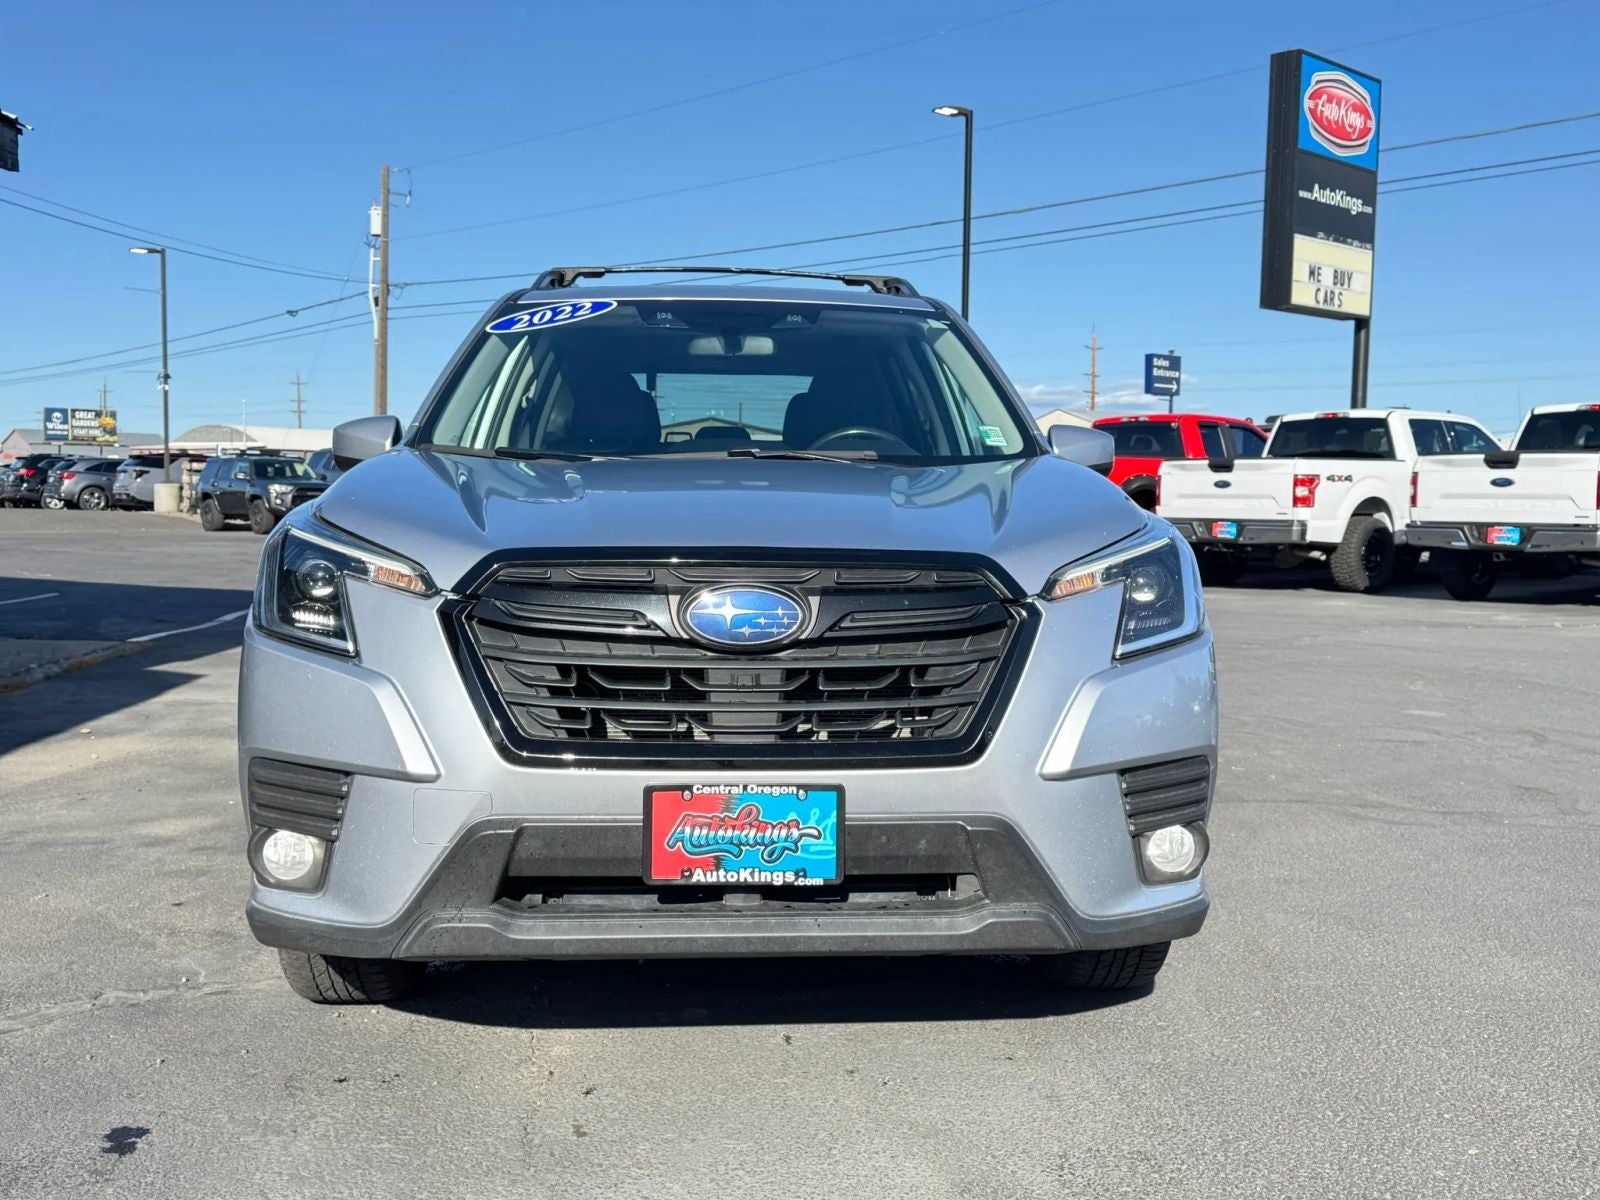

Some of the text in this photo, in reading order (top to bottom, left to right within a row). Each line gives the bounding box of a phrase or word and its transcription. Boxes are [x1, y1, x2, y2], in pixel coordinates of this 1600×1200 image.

[1298, 183, 1373, 215] www.AutoKings.com
[1308, 264, 1353, 289] WE BUY
[1315, 288, 1343, 308] CARS
[511, 303, 592, 330] 2022
[75, 411, 95, 419] GREAT
[692, 784, 798, 796] Central Oregon
[691, 868, 824, 886] AutoKings.com
